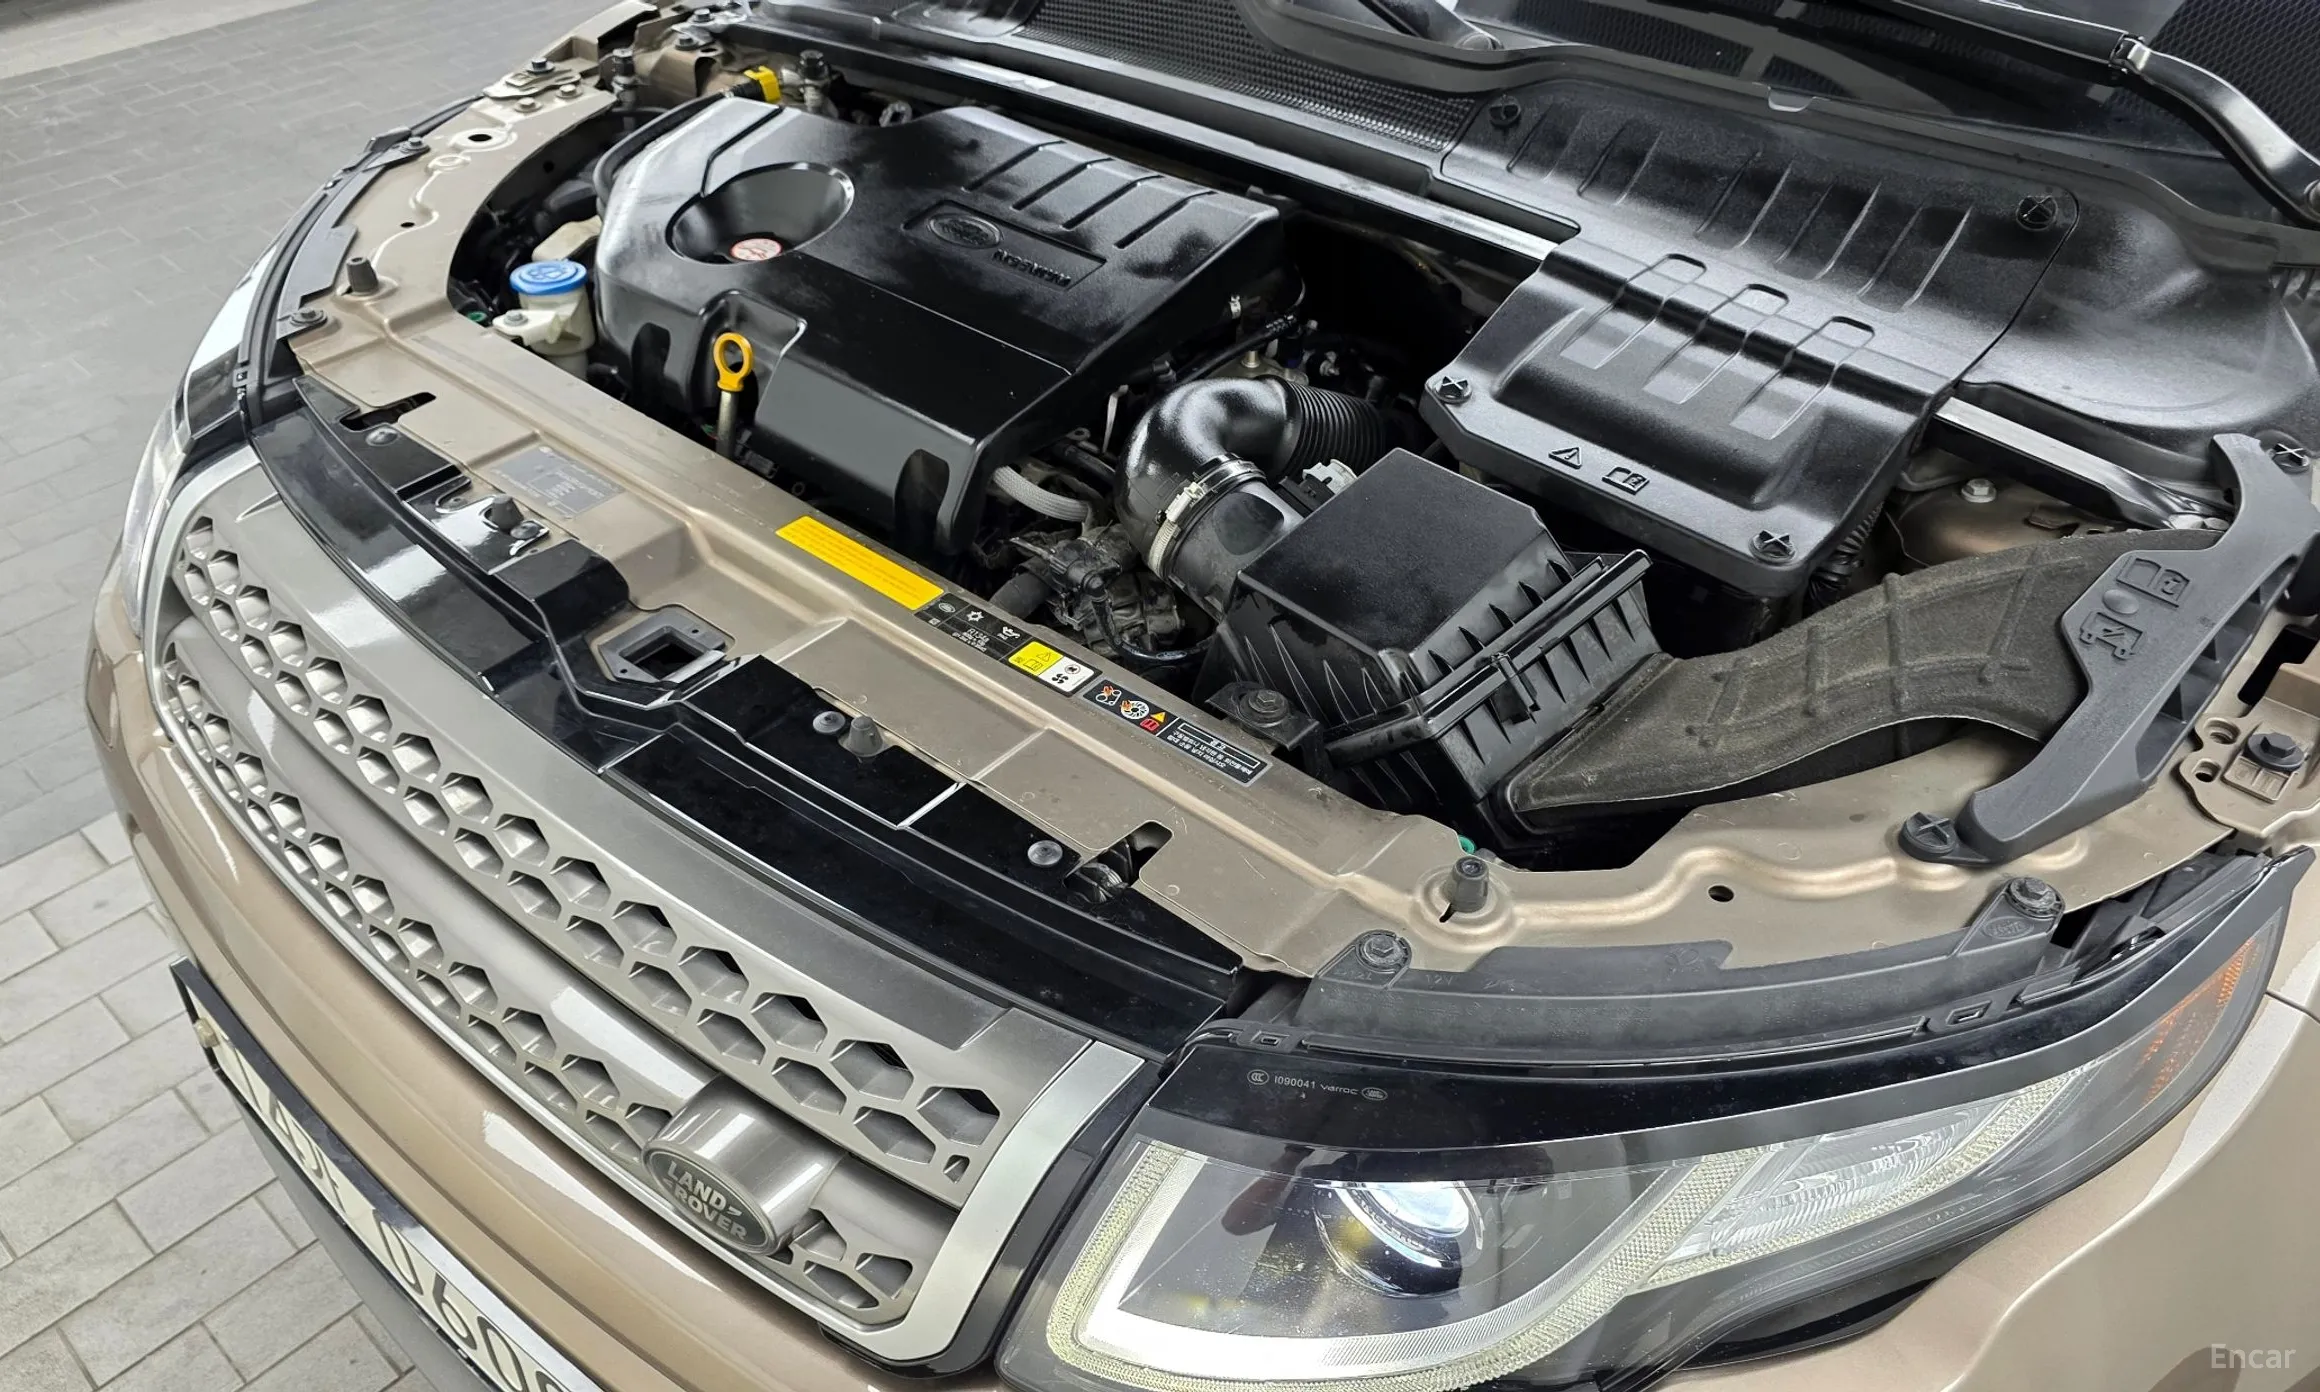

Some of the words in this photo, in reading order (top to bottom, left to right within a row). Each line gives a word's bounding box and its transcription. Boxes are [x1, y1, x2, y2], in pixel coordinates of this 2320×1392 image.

[667, 1160, 727, 1212] LAND
[673, 1186, 748, 1241] ROVER
[372, 1208, 564, 1392] 060
